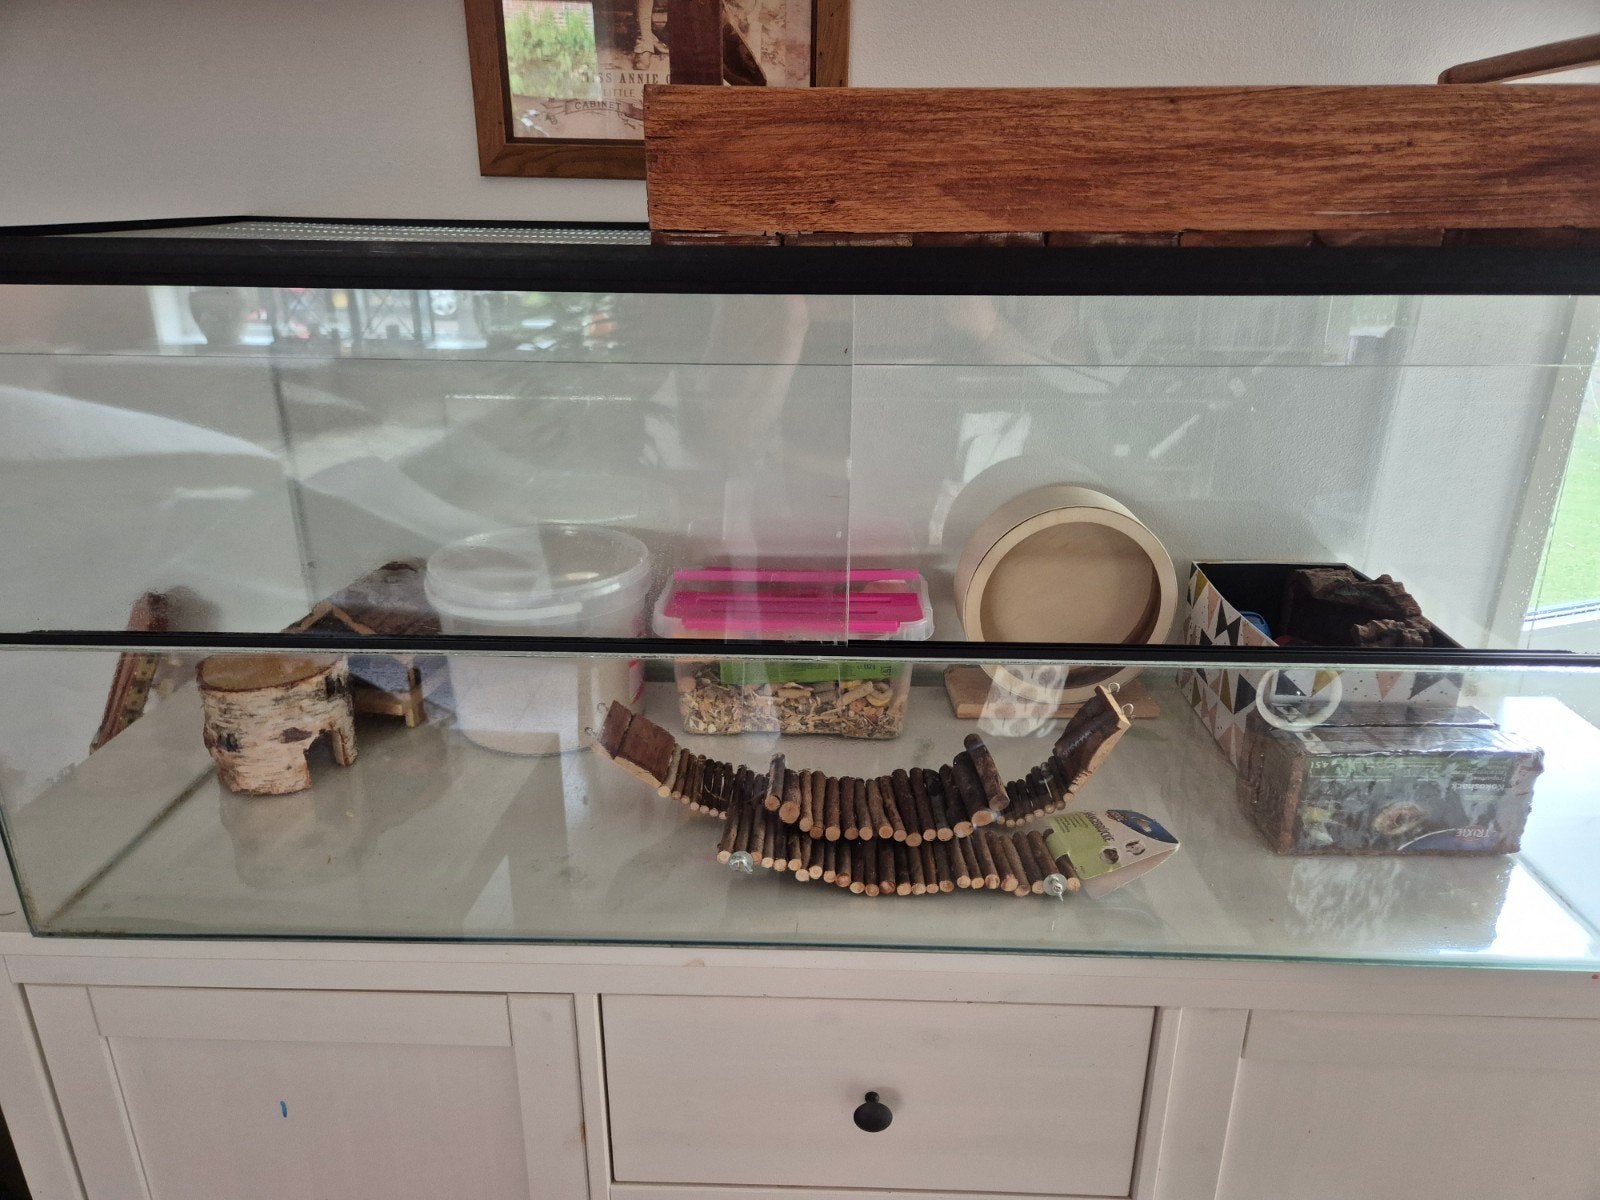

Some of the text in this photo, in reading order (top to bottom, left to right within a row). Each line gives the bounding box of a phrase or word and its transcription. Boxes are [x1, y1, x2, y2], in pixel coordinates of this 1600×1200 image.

[619, 73, 659, 84] ANNIE
[603, 88, 634, 97] LITTLE
[574, 101, 621, 111] CABINET
[1456, 828, 1490, 838] TRIXIE
